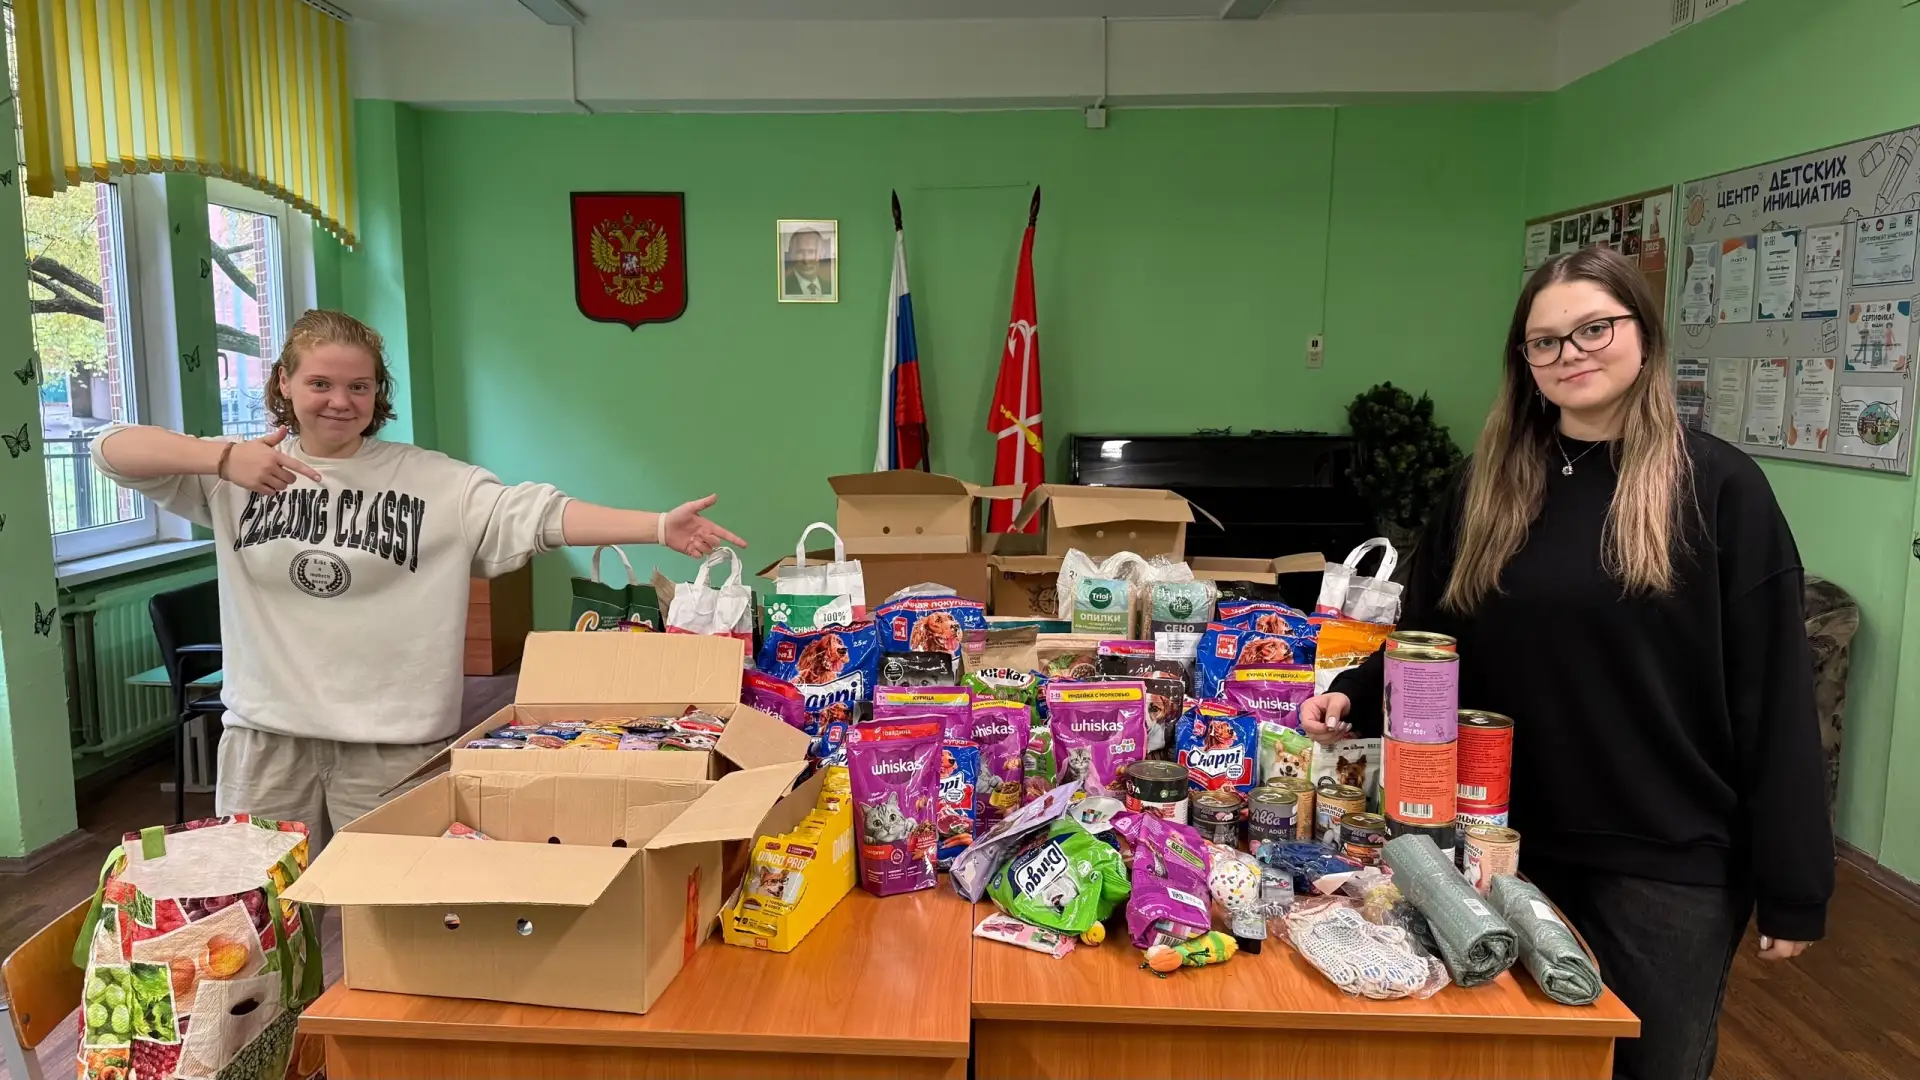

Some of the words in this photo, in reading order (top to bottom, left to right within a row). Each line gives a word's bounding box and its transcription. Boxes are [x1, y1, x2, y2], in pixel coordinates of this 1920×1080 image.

[1769, 155, 1847, 192] ДЕТСКИХ
[1717, 184, 1760, 209] ЦЕНТР
[1763, 179, 1852, 213] ИНИЦИАТИВ
[1861, 313, 1895, 322] СЕРТИФИКАТ
[333, 489, 425, 573] CLASSY
[1092, 592, 1109, 601] Triol
[823, 611, 846, 622] 100%
[1080, 613, 1121, 623] ОПИЛКИ
[1164, 624, 1195, 633] СЕНО
[1248, 697, 1297, 711] whiskas
[1071, 719, 1124, 732] whiskas
[1187, 750, 1242, 769] Chappi
[872, 758, 922, 776] whiskas
[757, 851, 785, 866] DINGO
[1025, 847, 1062, 893] Dingo
